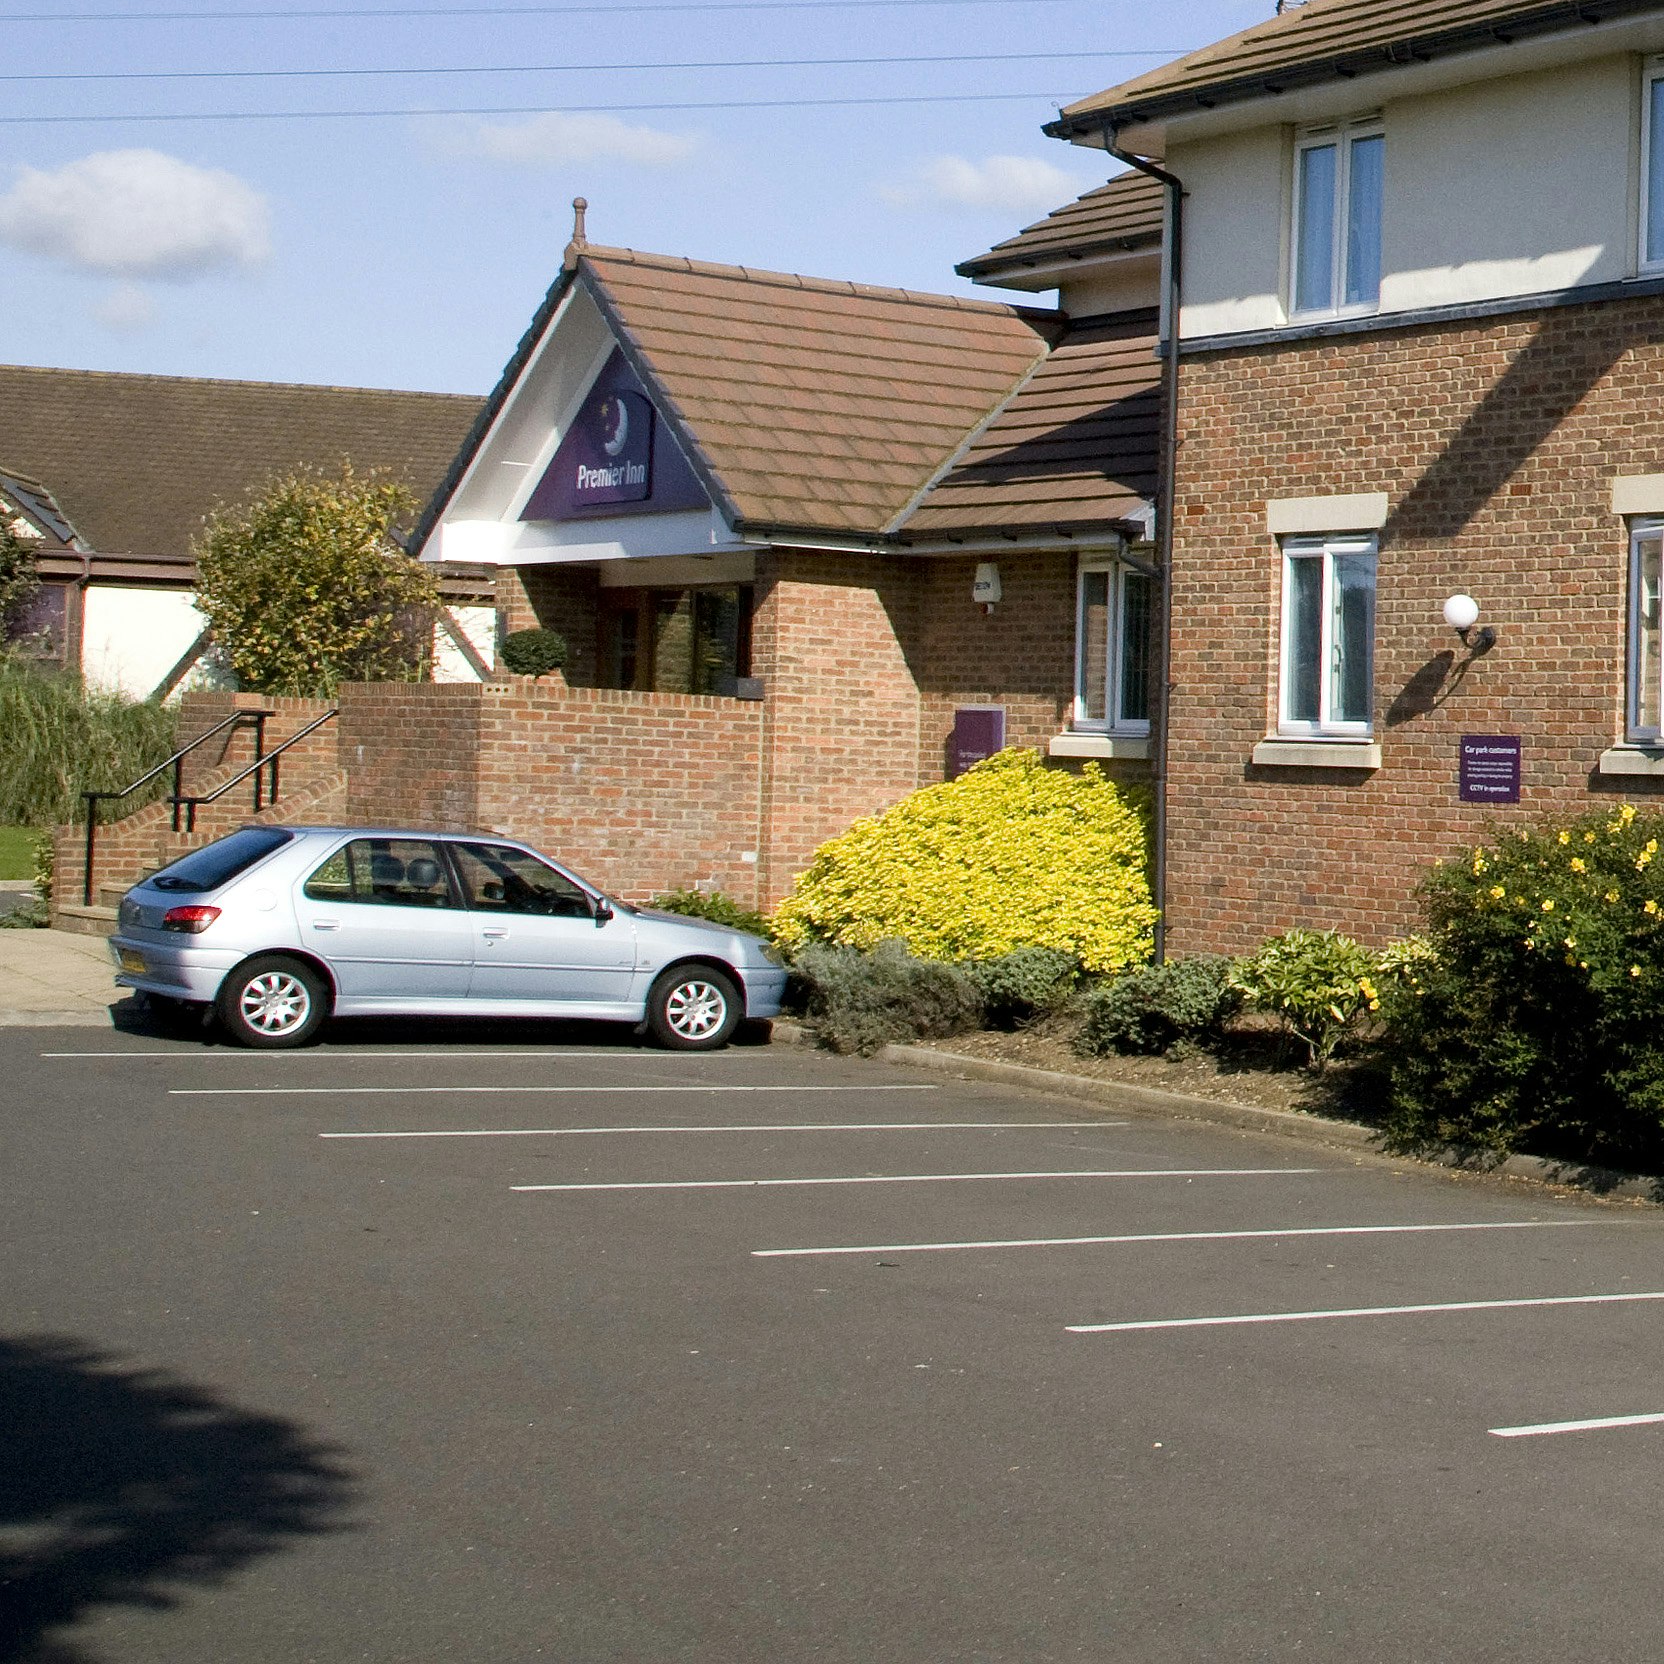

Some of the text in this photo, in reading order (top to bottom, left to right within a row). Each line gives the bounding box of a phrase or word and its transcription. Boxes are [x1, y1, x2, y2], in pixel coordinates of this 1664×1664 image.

[577, 460, 645, 489] Premier Inn
[1465, 745, 1475, 753] Car
[1476, 746, 1488, 755] park
